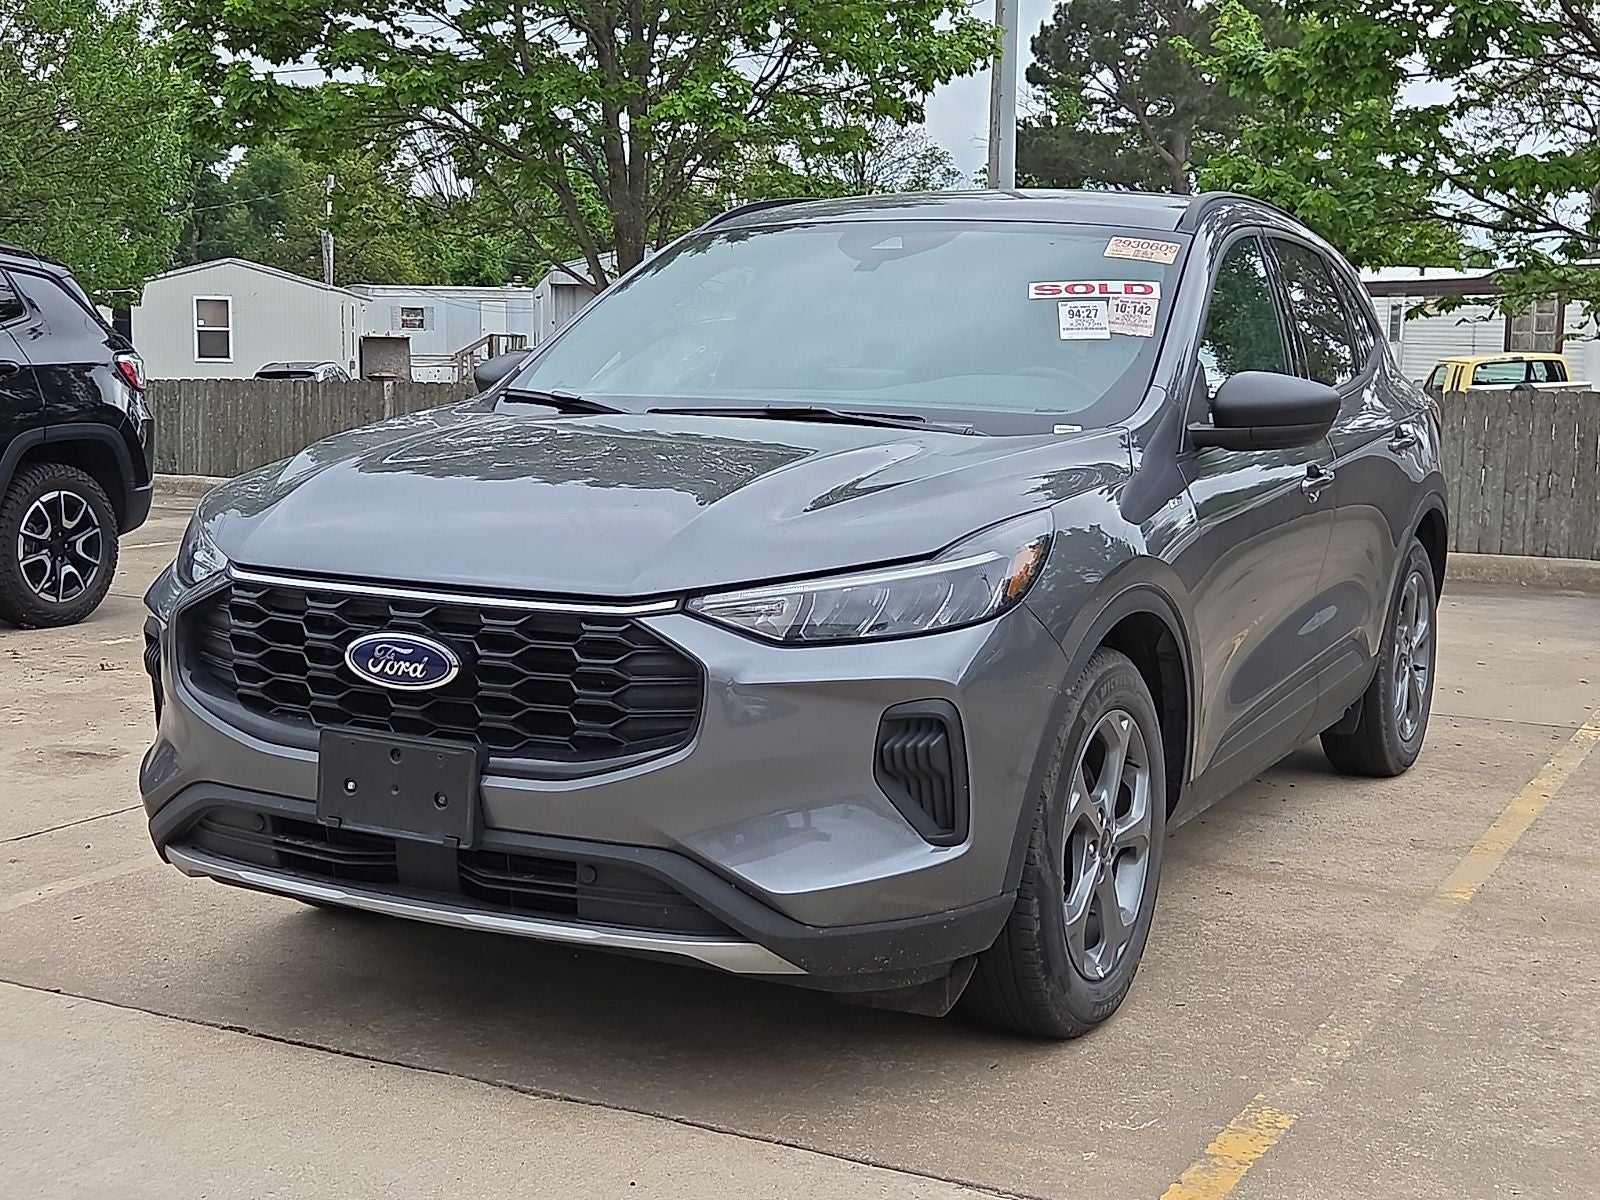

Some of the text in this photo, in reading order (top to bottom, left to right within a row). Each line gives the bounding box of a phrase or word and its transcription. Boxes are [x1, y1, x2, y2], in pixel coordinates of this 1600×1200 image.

[1034, 283, 1154, 296] SOLD
[1068, 308, 1099, 319] 94:27
[1114, 303, 1152, 316] 10:142
[367, 643, 429, 679] Ford
